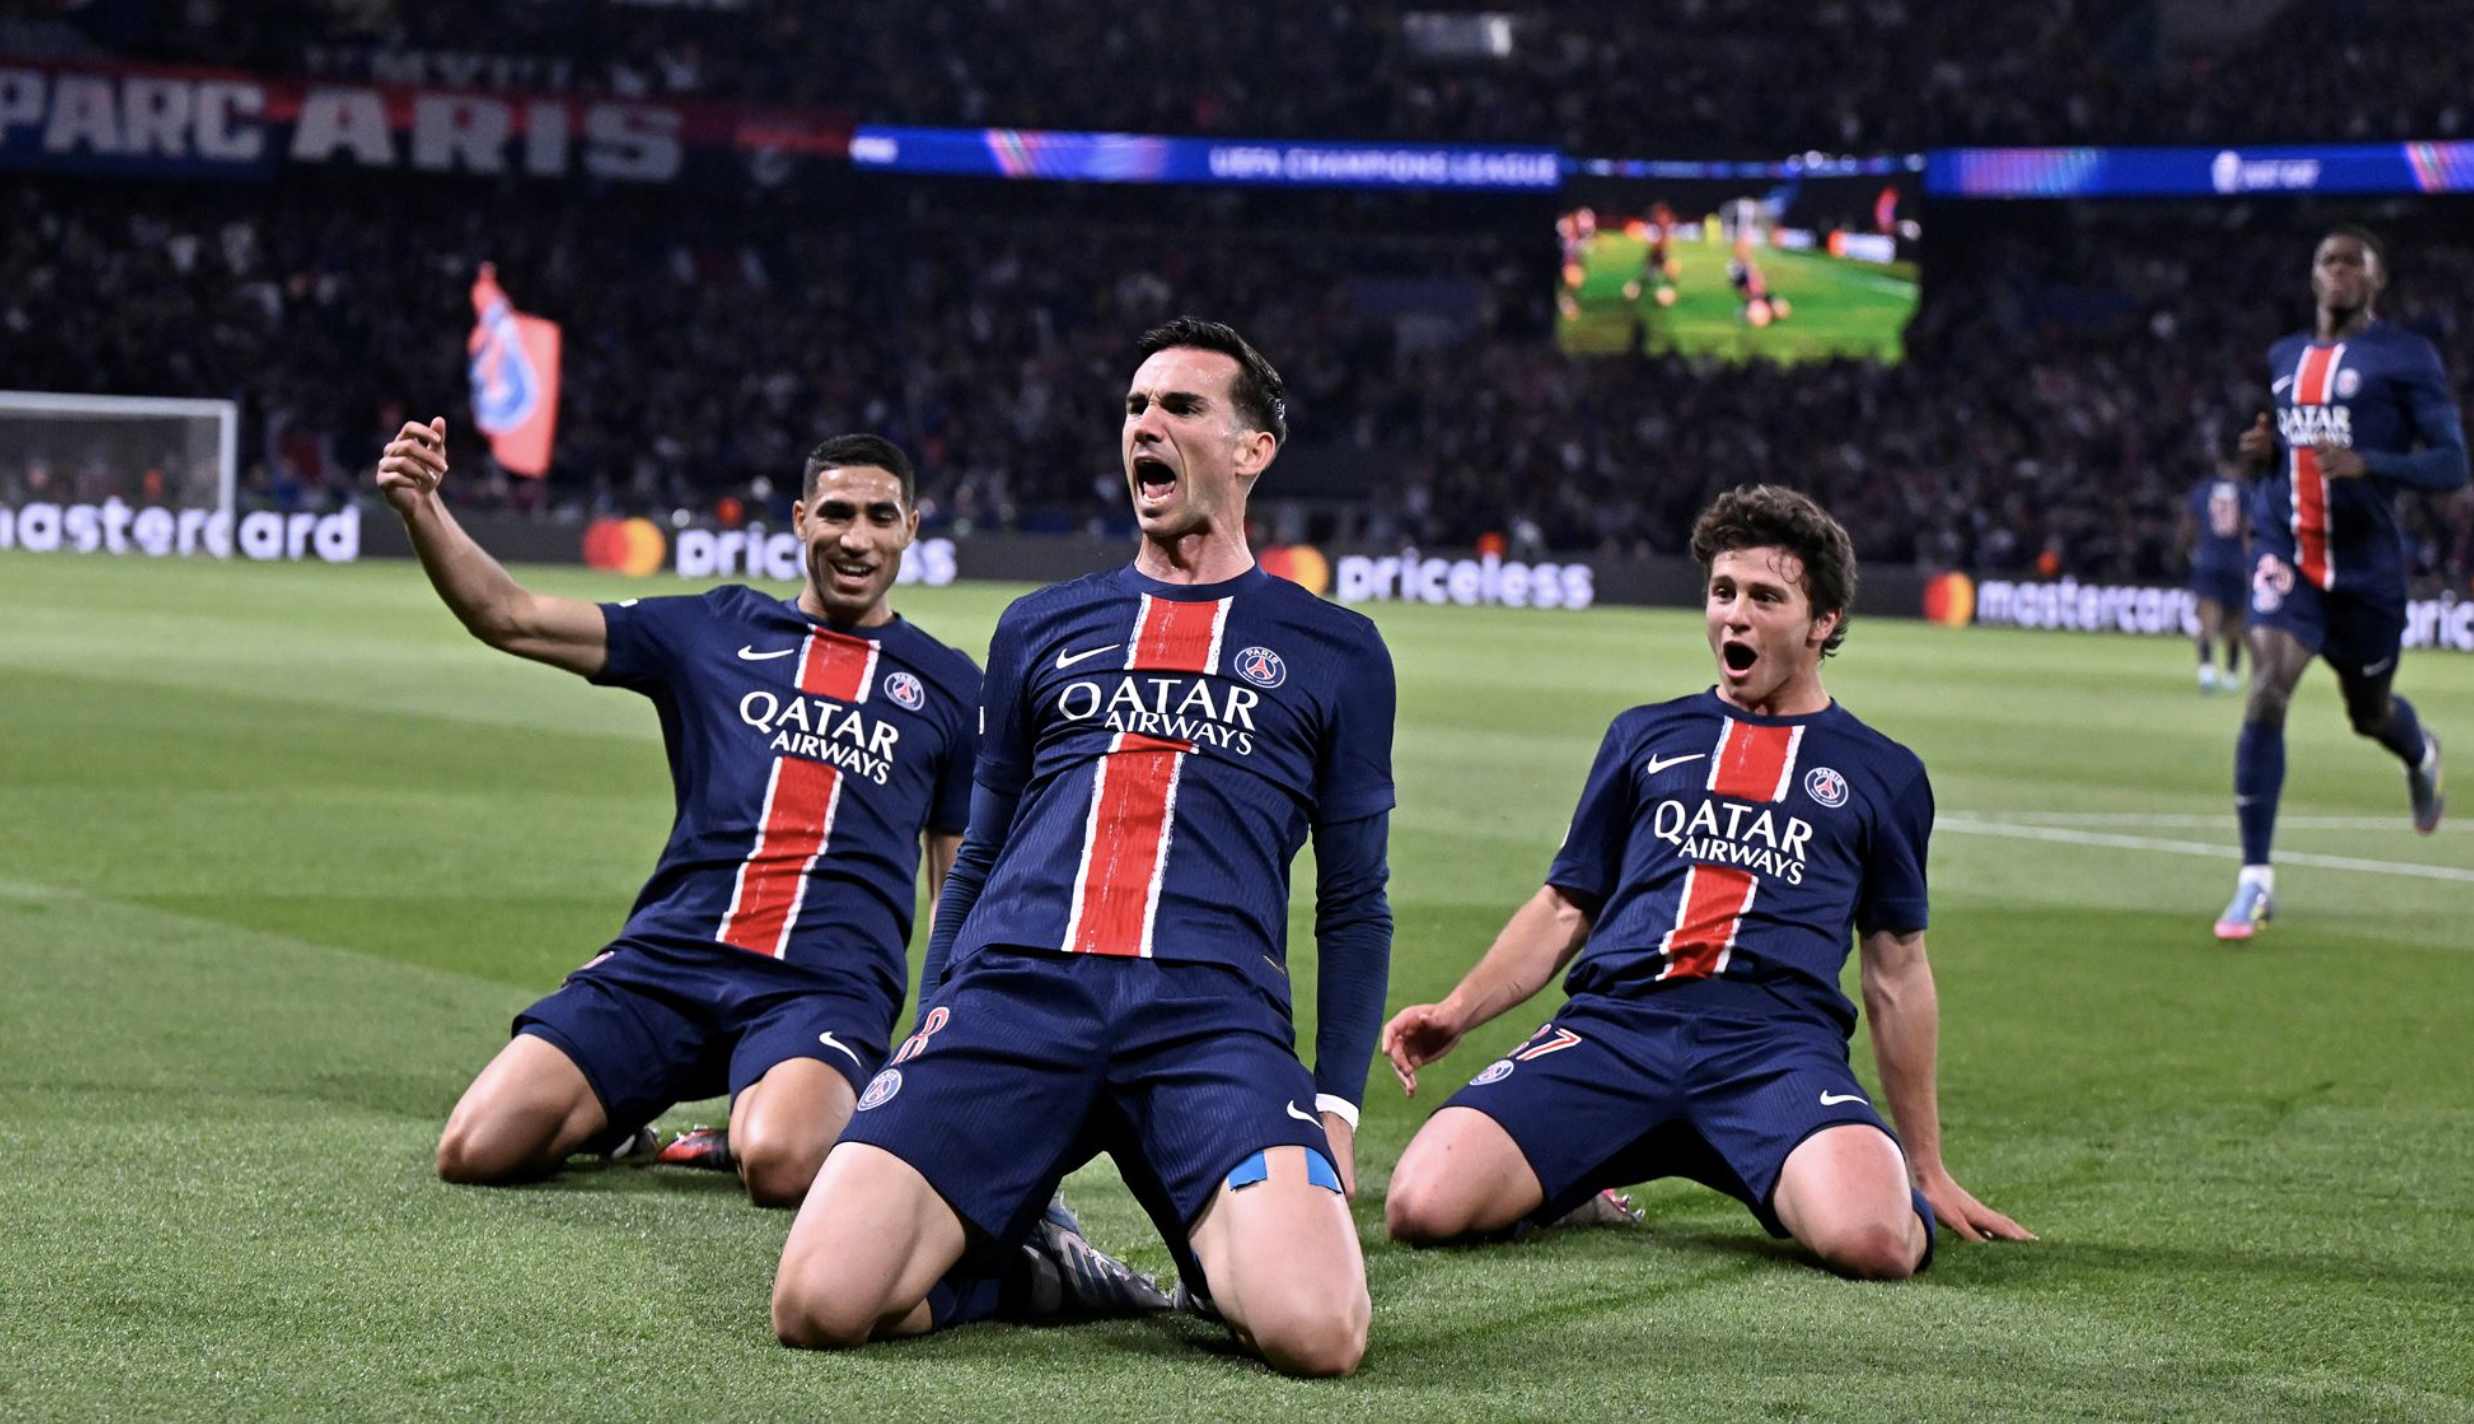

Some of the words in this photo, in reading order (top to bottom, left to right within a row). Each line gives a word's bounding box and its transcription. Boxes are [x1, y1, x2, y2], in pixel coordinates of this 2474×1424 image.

[0, 68, 265, 162] PARC
[1337, 548, 1594, 609] priceless
[740, 691, 899, 762] QATAR
[1059, 676, 1258, 731] QATAR
[770, 730, 890, 785] AIRWAYS
[1104, 711, 1254, 756] AIRWAYS
[1654, 799, 1813, 862] QATAR
[1678, 835, 1805, 885] AIRWAYS
